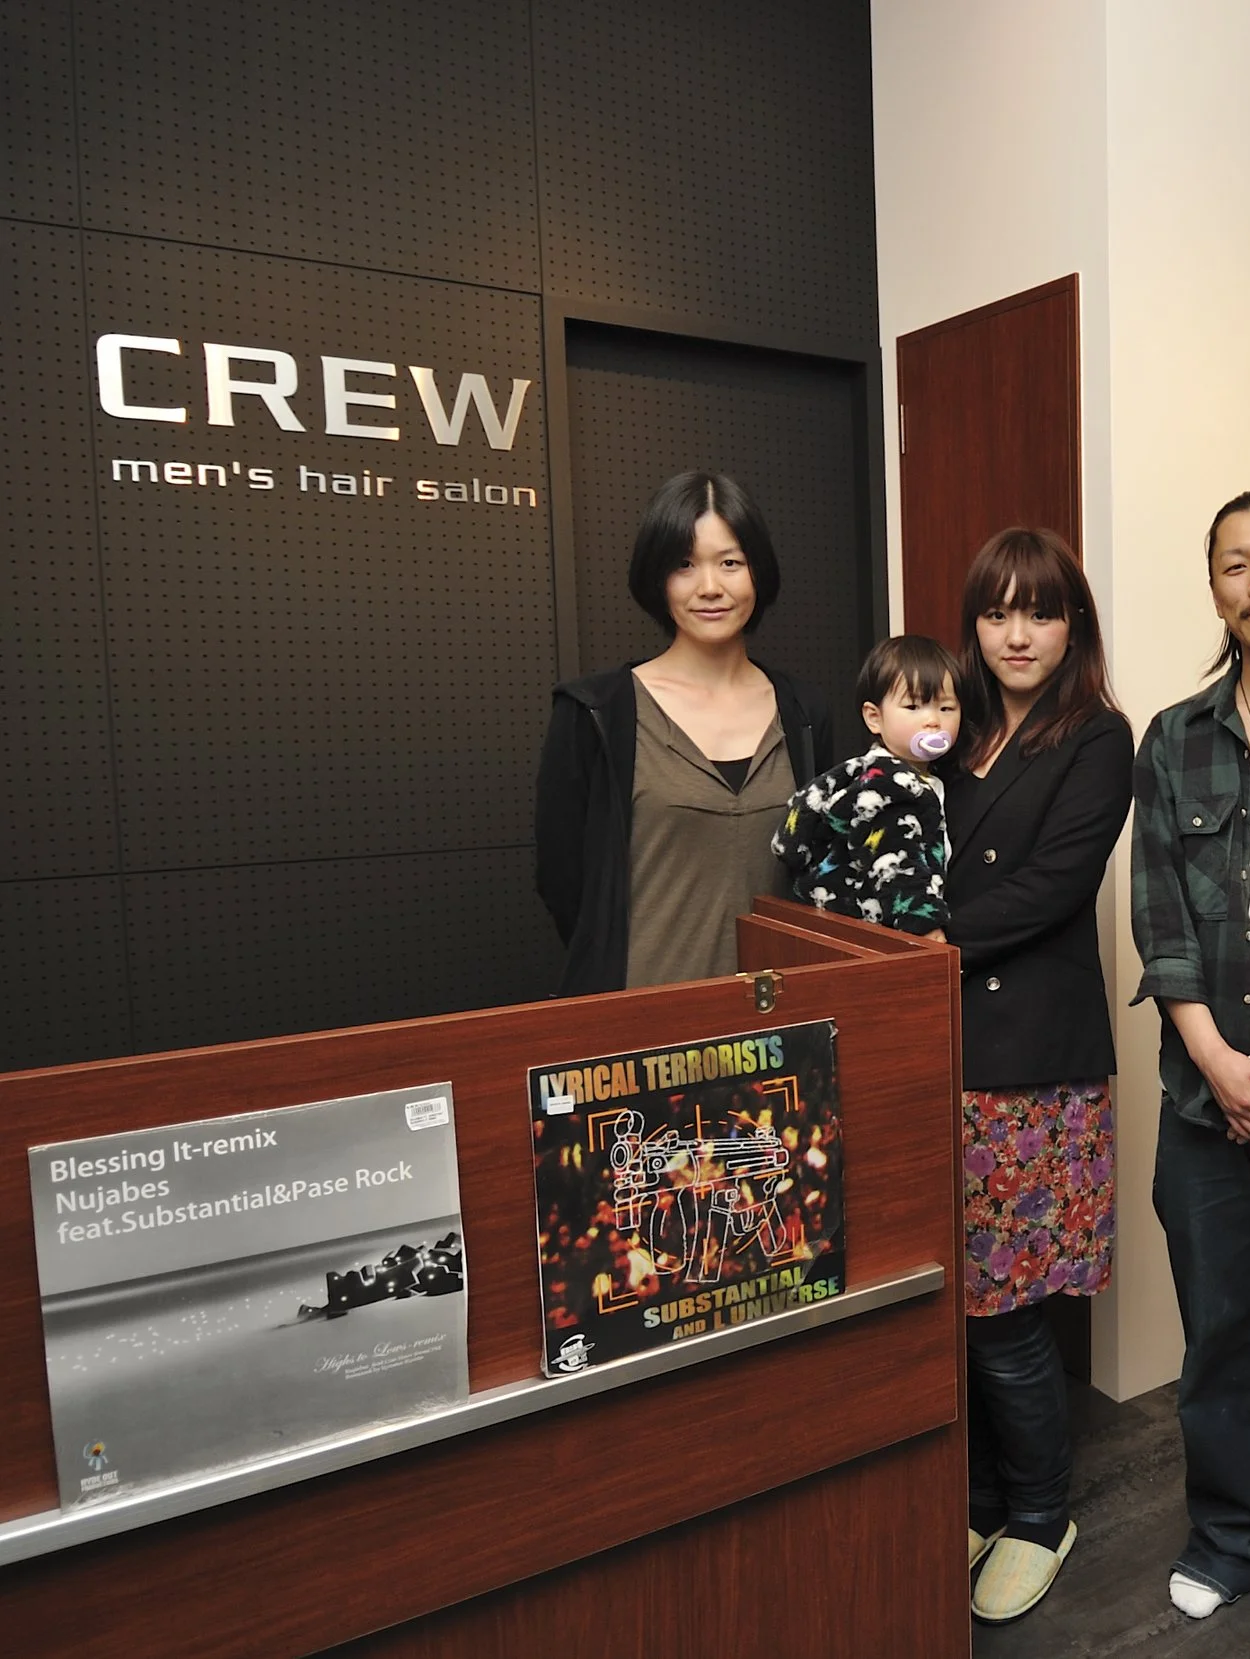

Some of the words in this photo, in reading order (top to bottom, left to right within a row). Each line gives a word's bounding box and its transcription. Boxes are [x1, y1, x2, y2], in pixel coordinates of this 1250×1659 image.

[96, 333, 532, 451] CREW
[111, 459, 274, 490] men's
[299, 465, 394, 497] hair
[416, 477, 537, 508] salon
[539, 1062, 641, 1111] LYRICAL
[642, 1035, 785, 1090] TERRORISTS
[50, 1146, 166, 1182] Blessing
[355, 1160, 413, 1190] Rock
[55, 1178, 170, 1214] Nujabes
[643, 1266, 805, 1329] SUBSTANTIAL
[672, 1319, 706, 1340] AND
[729, 1275, 840, 1325] UNIVERSE
